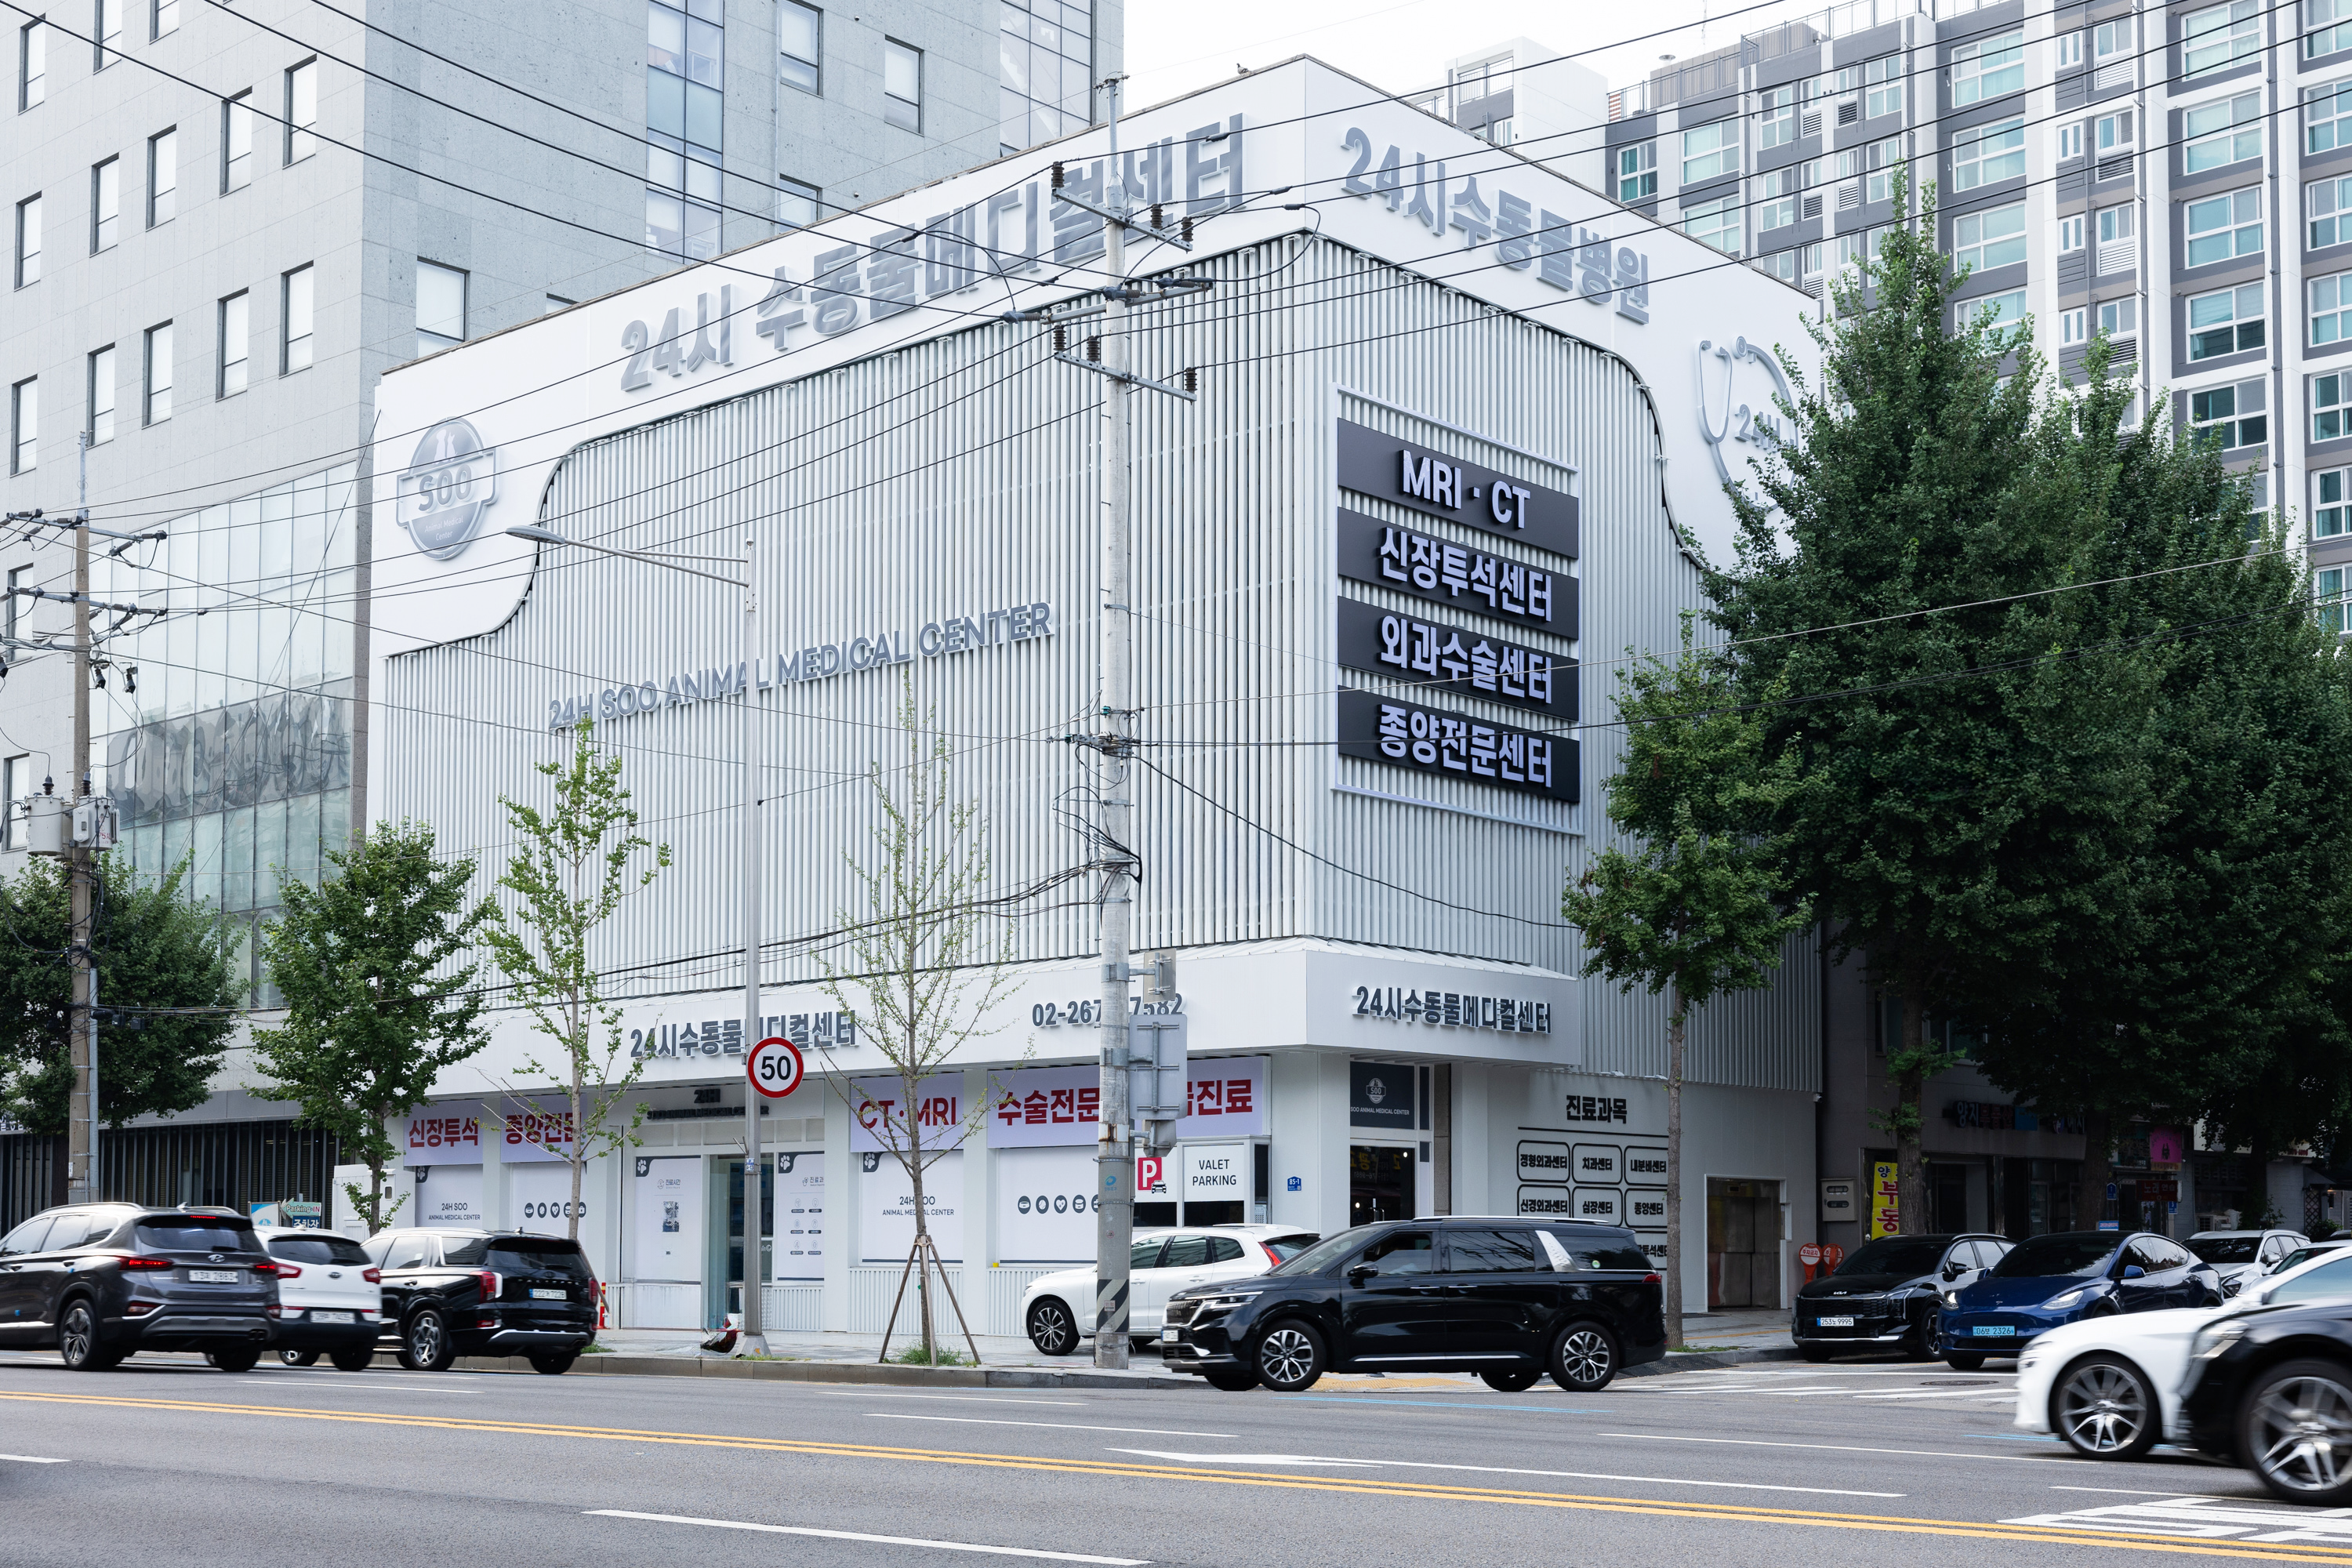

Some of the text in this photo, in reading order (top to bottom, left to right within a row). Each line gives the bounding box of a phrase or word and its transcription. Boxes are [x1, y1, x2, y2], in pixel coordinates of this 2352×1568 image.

[620, 112, 1245, 392] 24시 수동물메디컬센터
[419, 464, 472, 512] SOO
[1401, 450, 1461, 509] MRI
[1491, 480, 1530, 529] CT
[424, 516, 463, 533] Animal Medical
[435, 530, 453, 541] Center
[1380, 527, 1552, 622] 신장투석센터
[549, 601, 1053, 730] 24H SOO ANIMAL MEDICAL CENTER
[1380, 615, 1552, 704] 외과수술센터
[1379, 704, 1552, 788] 종양전문센터
[1355, 985, 1552, 1034] 24시수동물메디컬센터
[630, 1010, 856, 1058] 24시수동물디컬센터
[760, 1055, 791, 1080] 50
[998, 1087, 1100, 1127] 수술전문
[1566, 1094, 1628, 1124] 진료과목
[408, 1116, 479, 1149] 신장투석
[1199, 1159, 1229, 1170] VALET
[1520, 1153, 1567, 1169] 정형외과센터
[1582, 1156, 1613, 1171] 치과센터
[1630, 1159, 1667, 1173] 내분비센터
[1142, 1161, 1157, 1188] P
[1192, 1174, 1237, 1186] PARKING
[454, 1202, 468, 1210] SOO
[899, 1196, 936, 1205] 24H OO
[1521, 1199, 1567, 1213] 신경외과센터
[1582, 1201, 1613, 1214] 심장센터
[1635, 1202, 1664, 1215] 종양센터
